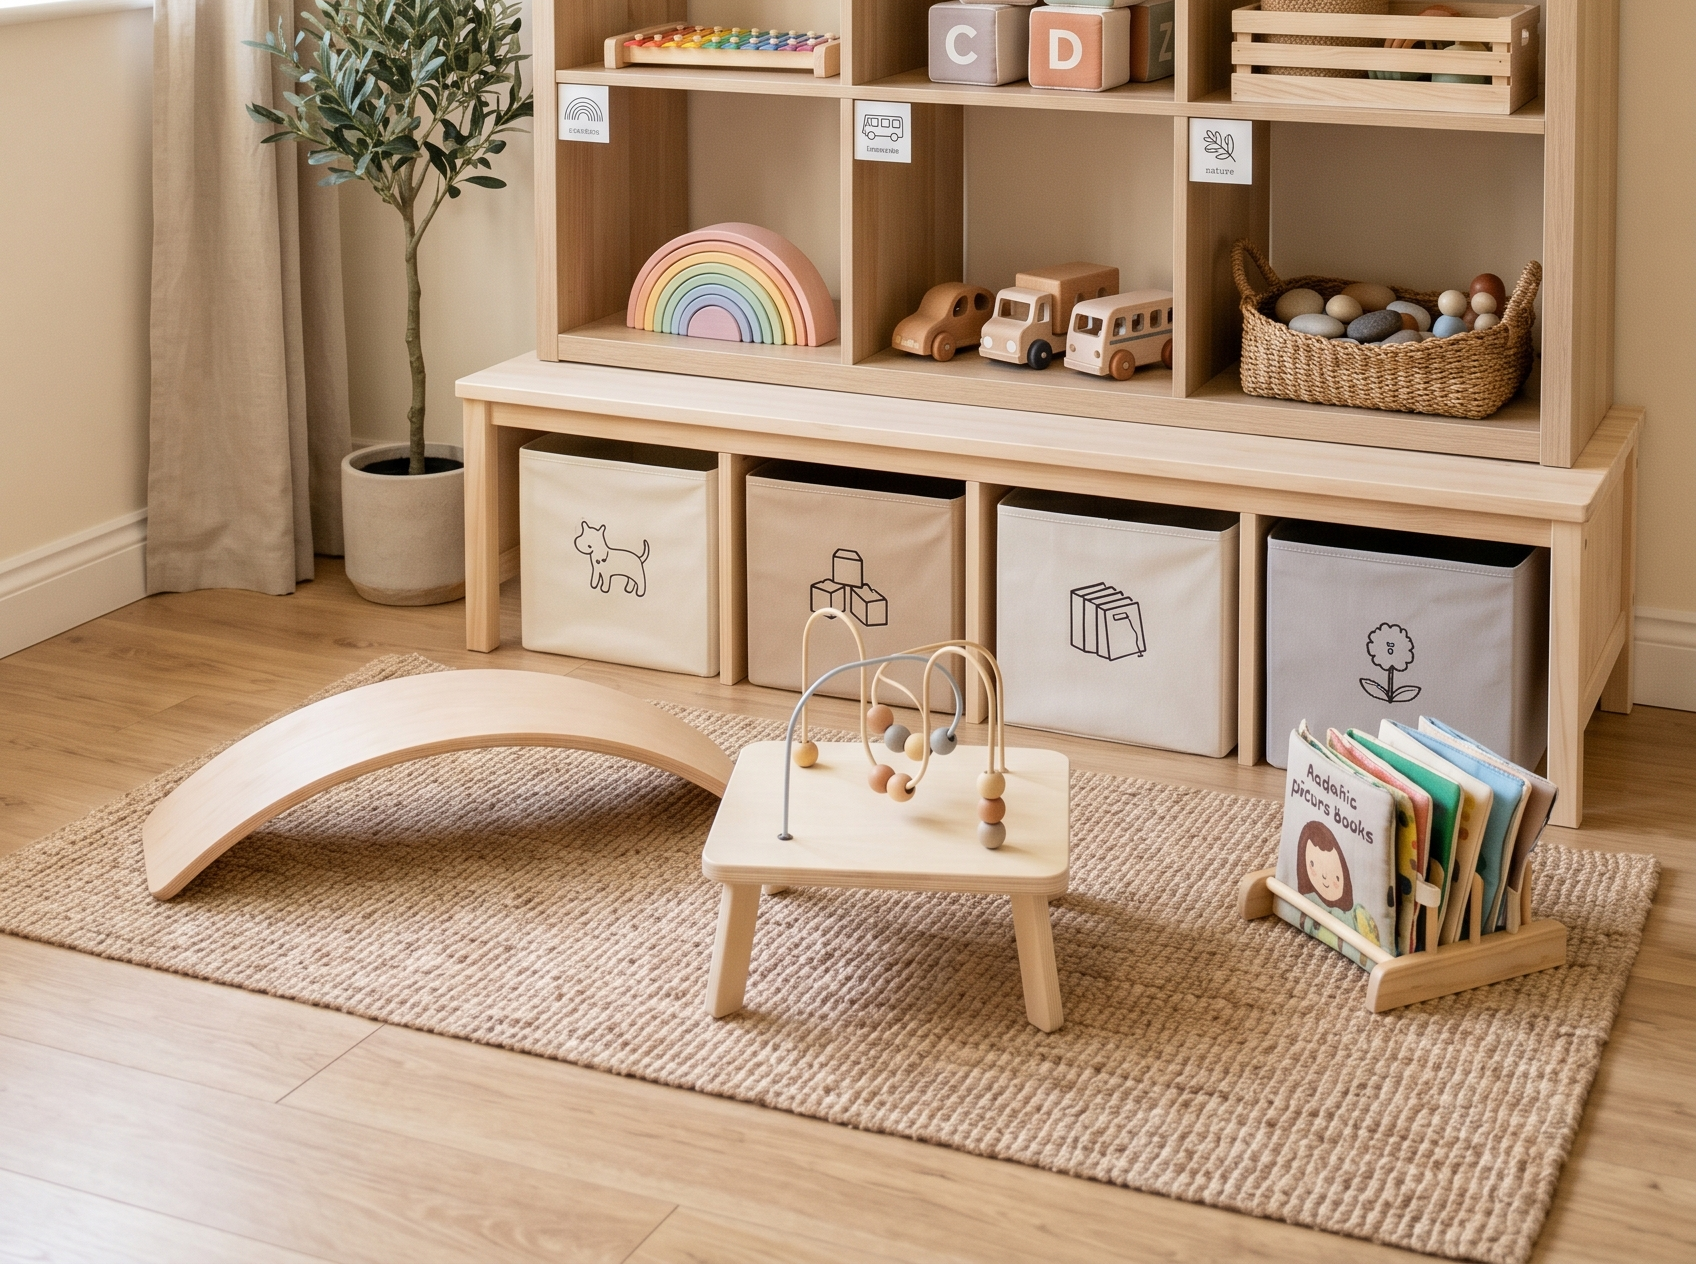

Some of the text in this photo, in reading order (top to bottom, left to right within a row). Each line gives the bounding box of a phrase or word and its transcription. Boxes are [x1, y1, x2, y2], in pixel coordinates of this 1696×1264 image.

[945, 24, 978, 66] C
[1048, 28, 1083, 70] D
[1158, 21, 1174, 63] Z
[1205, 167, 1235, 176] nature
